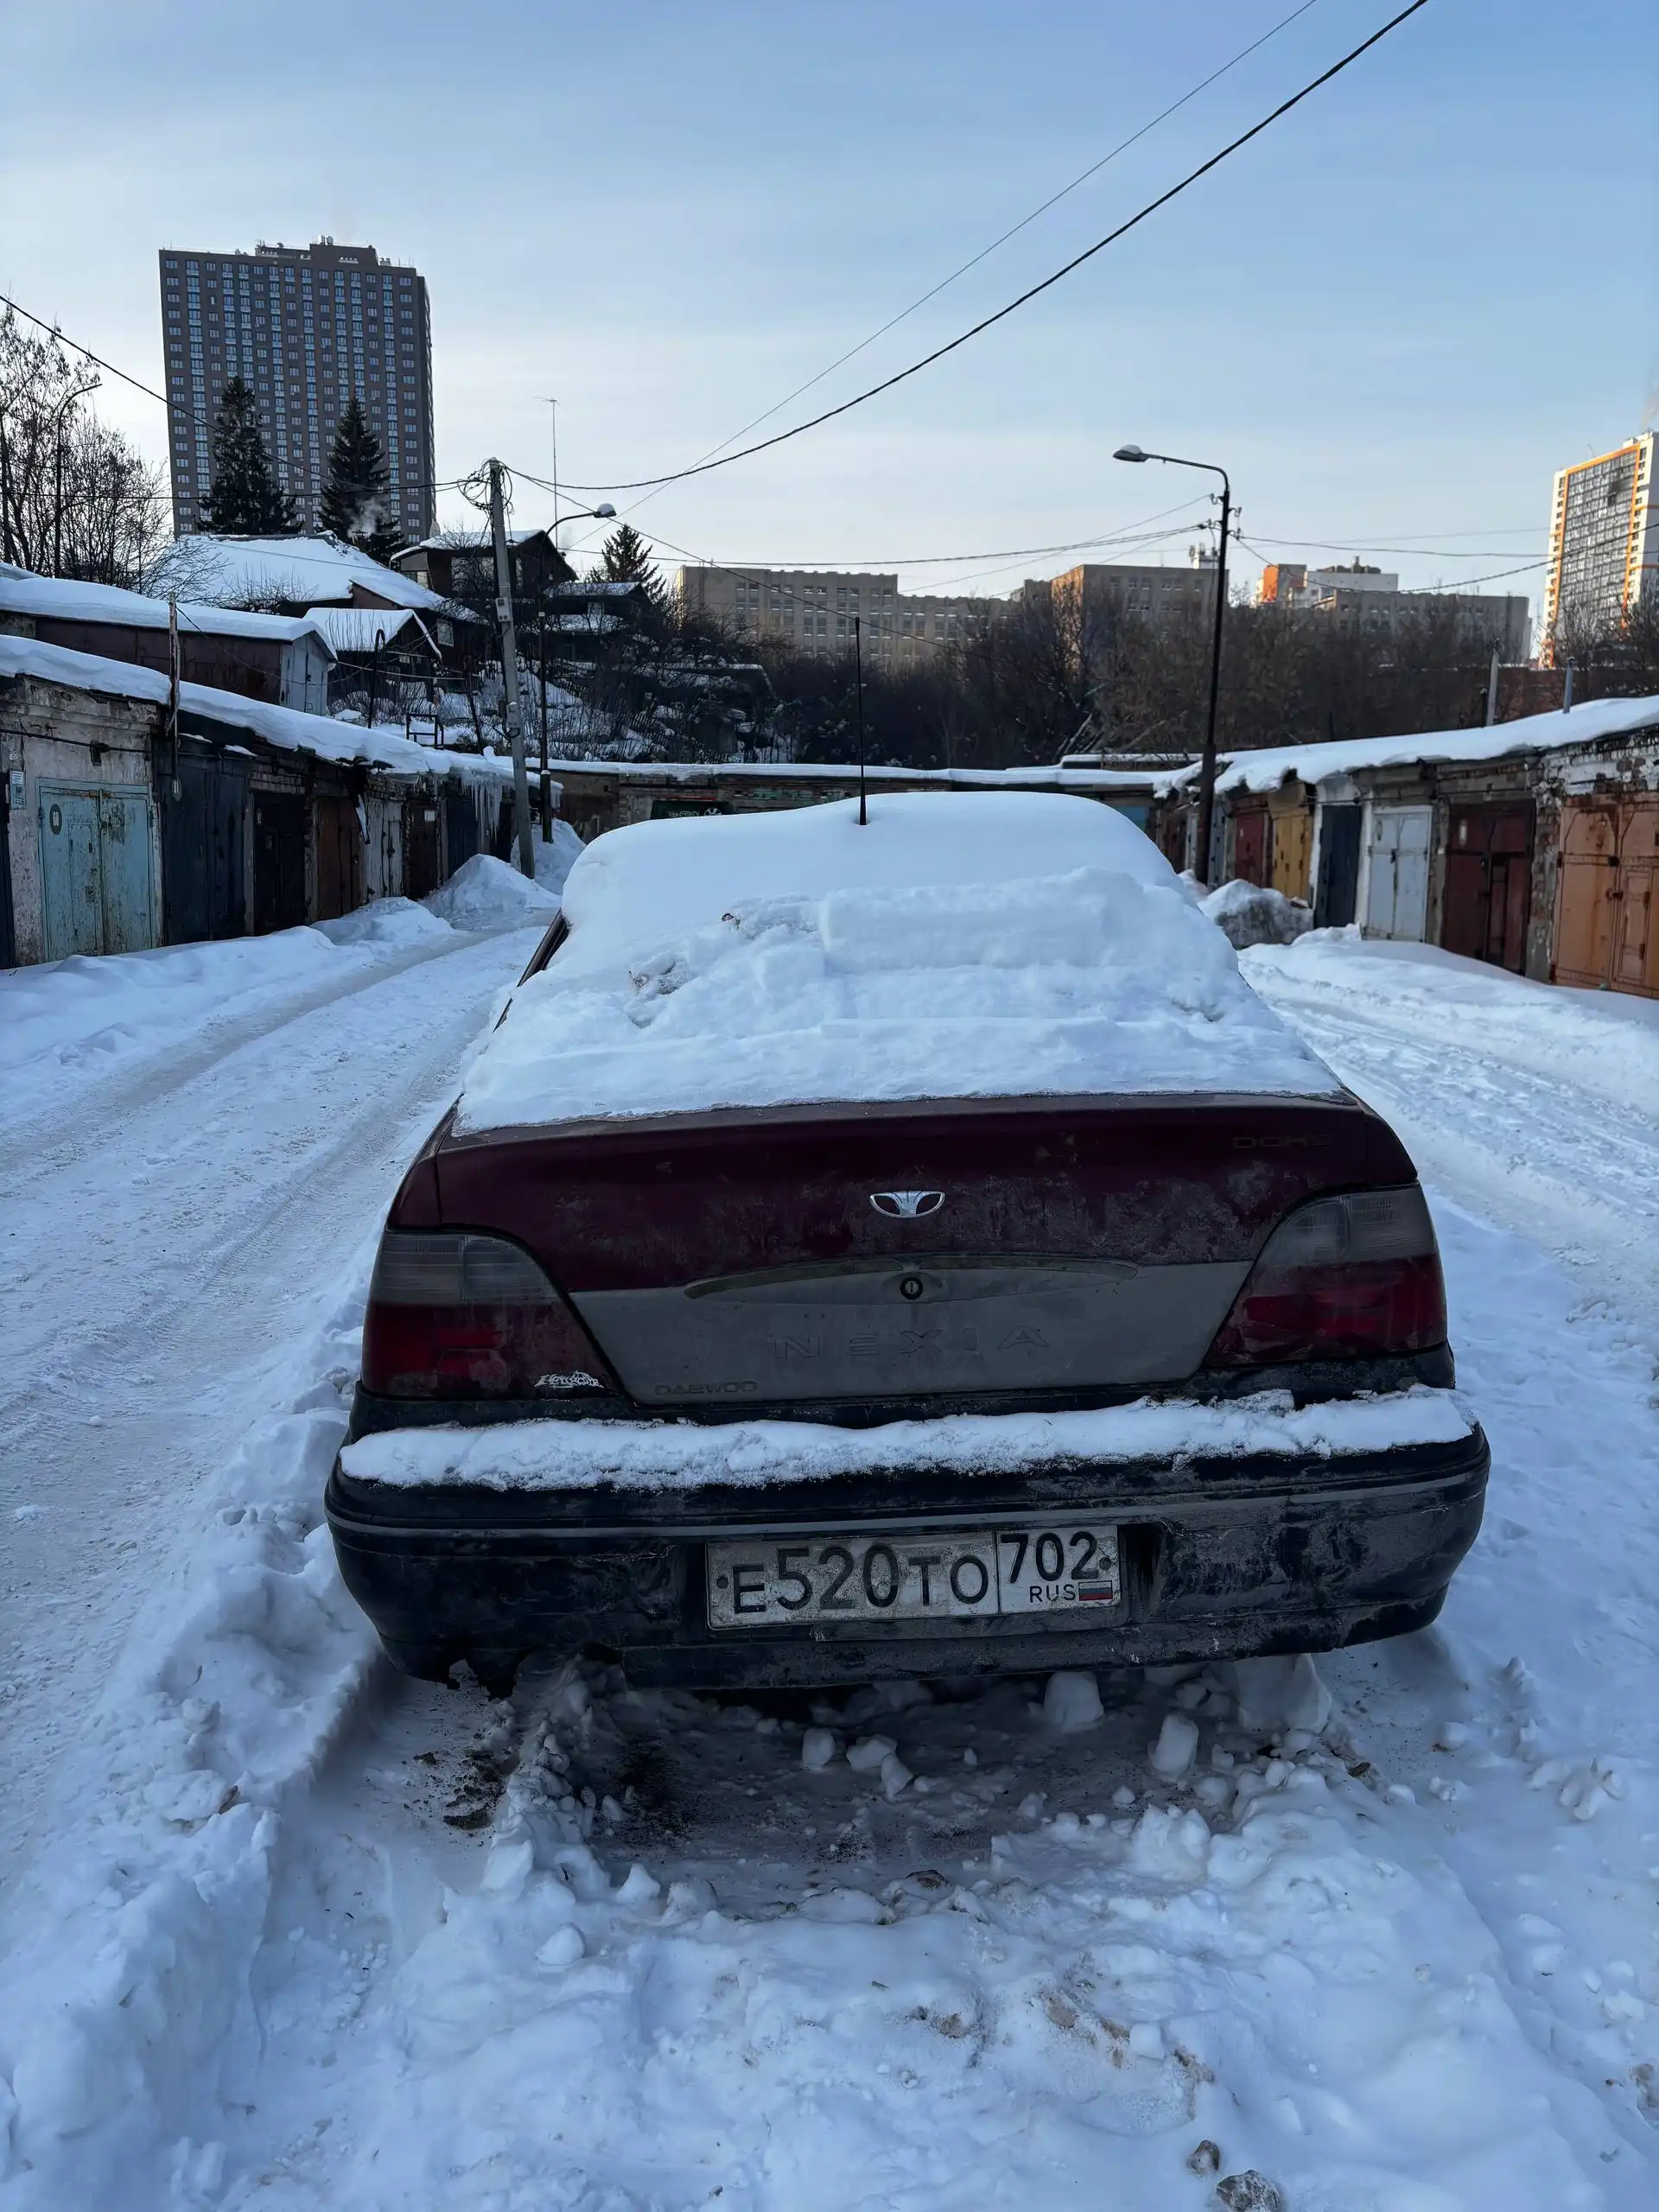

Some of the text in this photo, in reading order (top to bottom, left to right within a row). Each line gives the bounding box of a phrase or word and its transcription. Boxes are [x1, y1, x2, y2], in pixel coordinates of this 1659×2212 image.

[774, 1325, 1049, 1359] NEXIA
[655, 1380, 758, 1395] DAEWOO
[1000, 1531, 1100, 1584] 702
[1030, 1584, 1076, 1604] RUS
